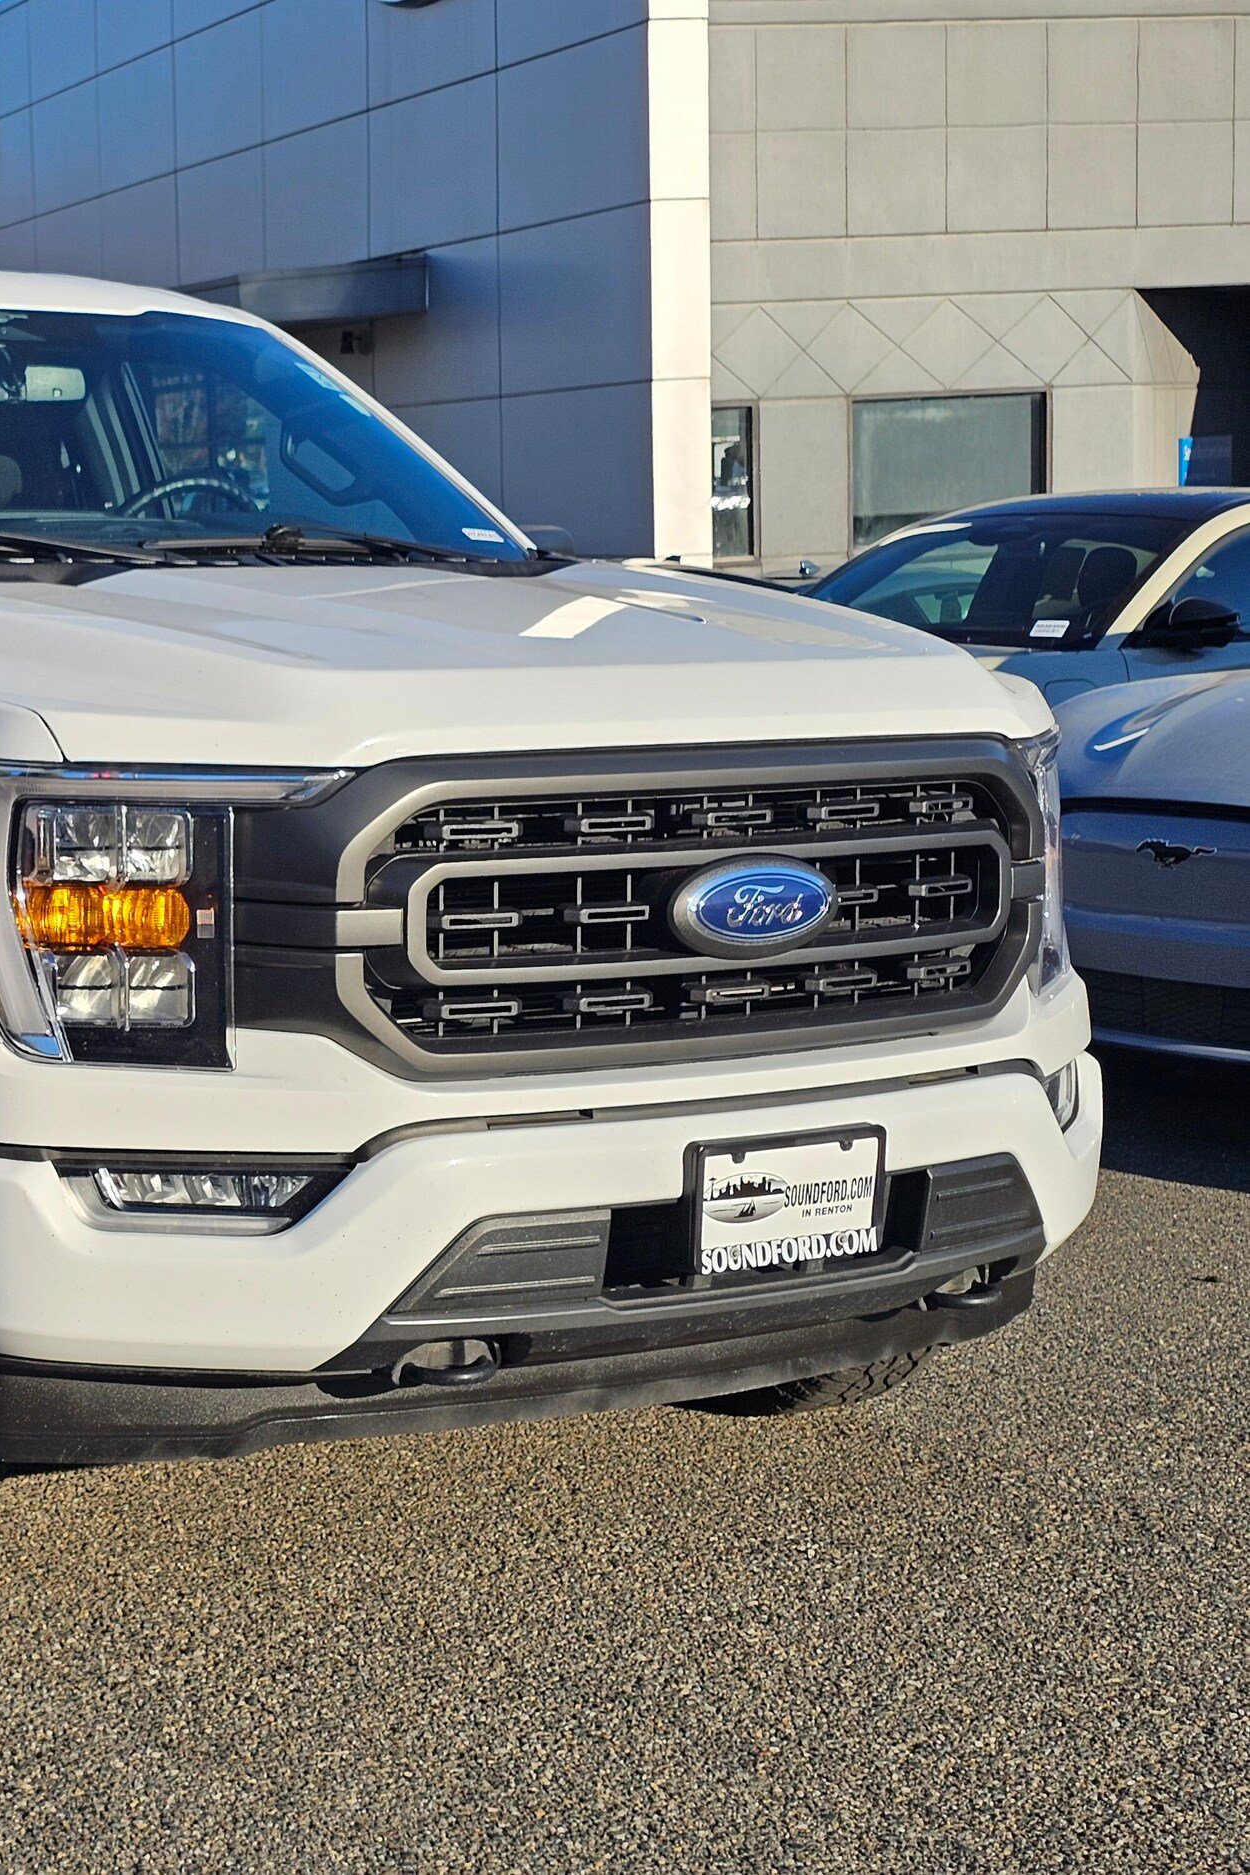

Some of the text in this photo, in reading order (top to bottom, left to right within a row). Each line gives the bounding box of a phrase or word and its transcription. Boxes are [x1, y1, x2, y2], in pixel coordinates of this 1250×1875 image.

[726, 884, 803, 928] Ford
[784, 1175, 873, 1208] SOUNDFORD.COM
[801, 1204, 853, 1218] IN RENTON
[701, 1226, 878, 1275] SOUNDFORD.COM
